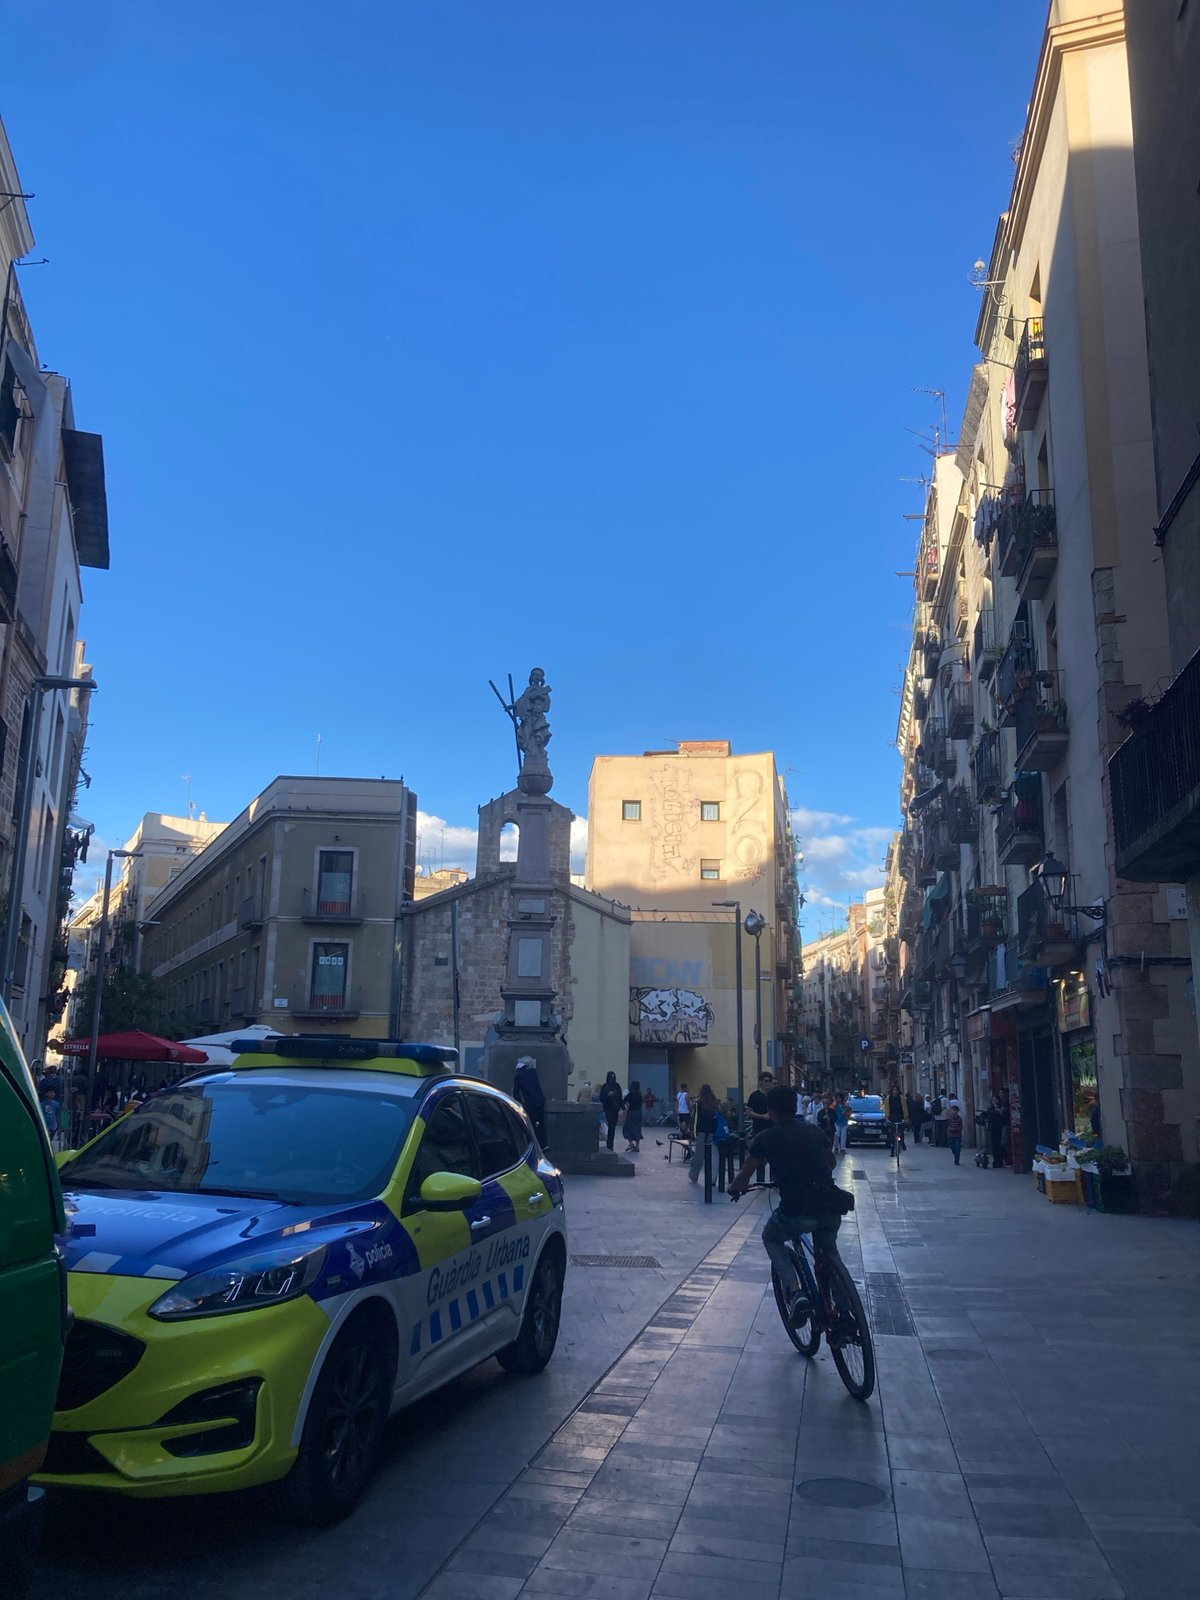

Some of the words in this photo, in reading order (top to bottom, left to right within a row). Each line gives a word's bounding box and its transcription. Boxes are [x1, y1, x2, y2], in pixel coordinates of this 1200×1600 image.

[861, 1040, 869, 1050] P
[365, 1240, 393, 1269] policia
[427, 1249, 482, 1306] Guàrdia
[486, 1235, 530, 1273] Urbana
